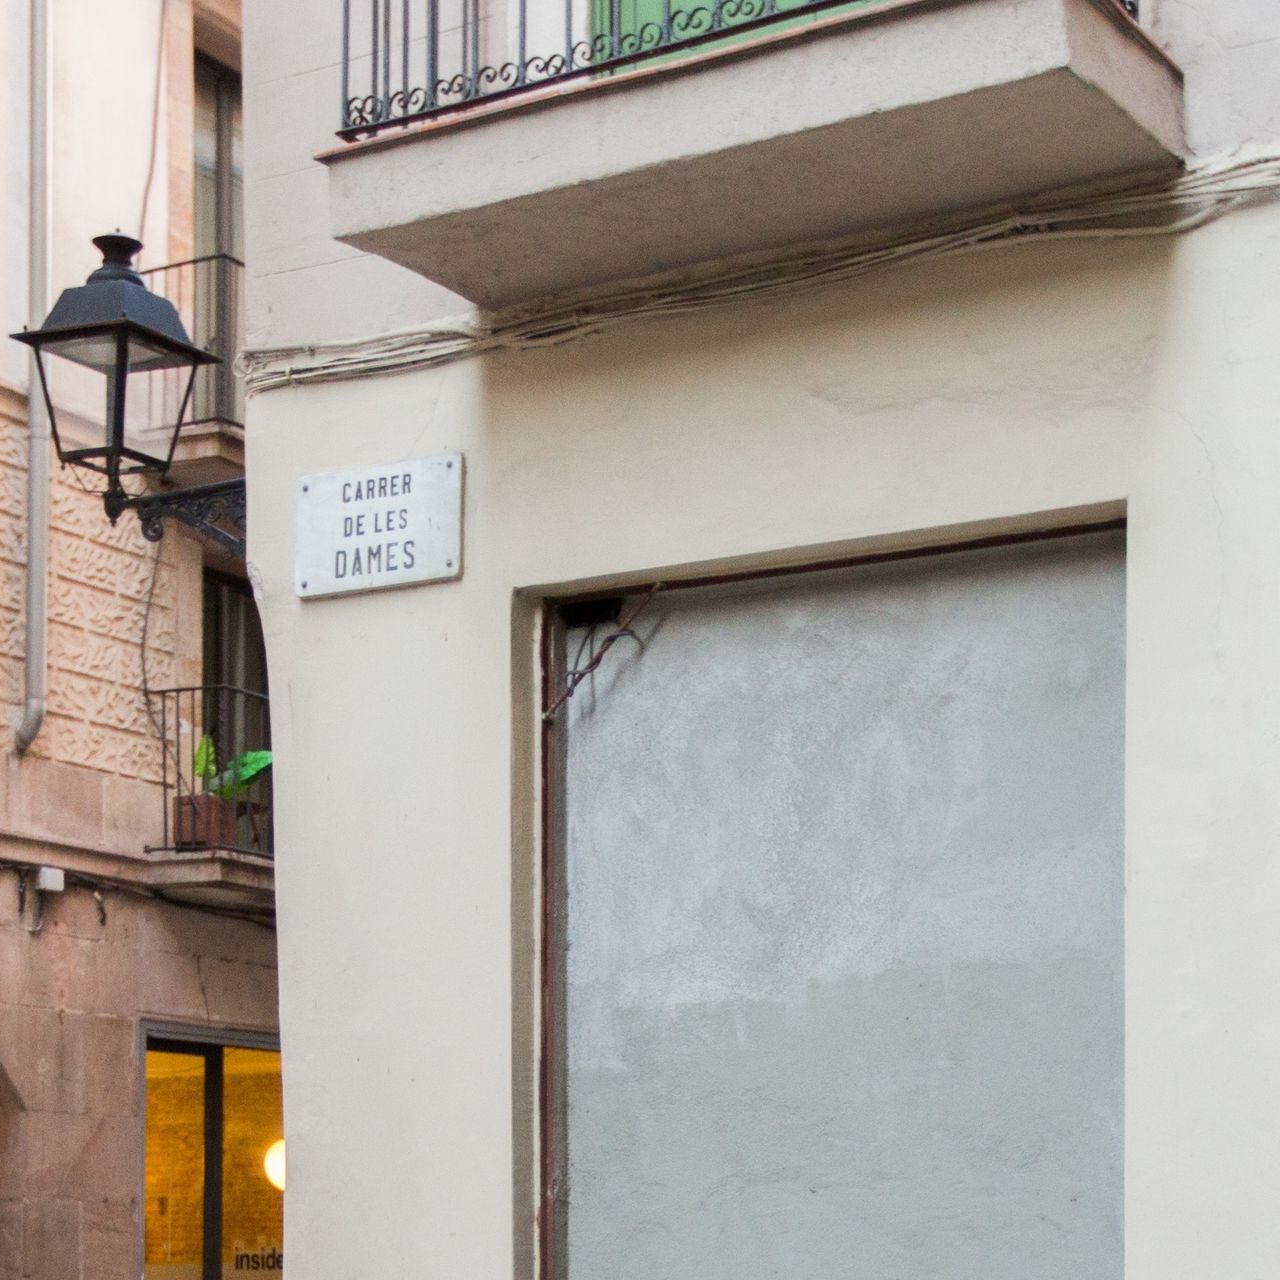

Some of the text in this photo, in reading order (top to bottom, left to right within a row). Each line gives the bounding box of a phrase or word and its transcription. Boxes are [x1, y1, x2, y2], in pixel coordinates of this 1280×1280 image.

[342, 473, 412, 503] CARRER
[344, 509, 408, 537] DE LES
[335, 540, 415, 579] DAMES
[235, 1248, 283, 1270] inside
